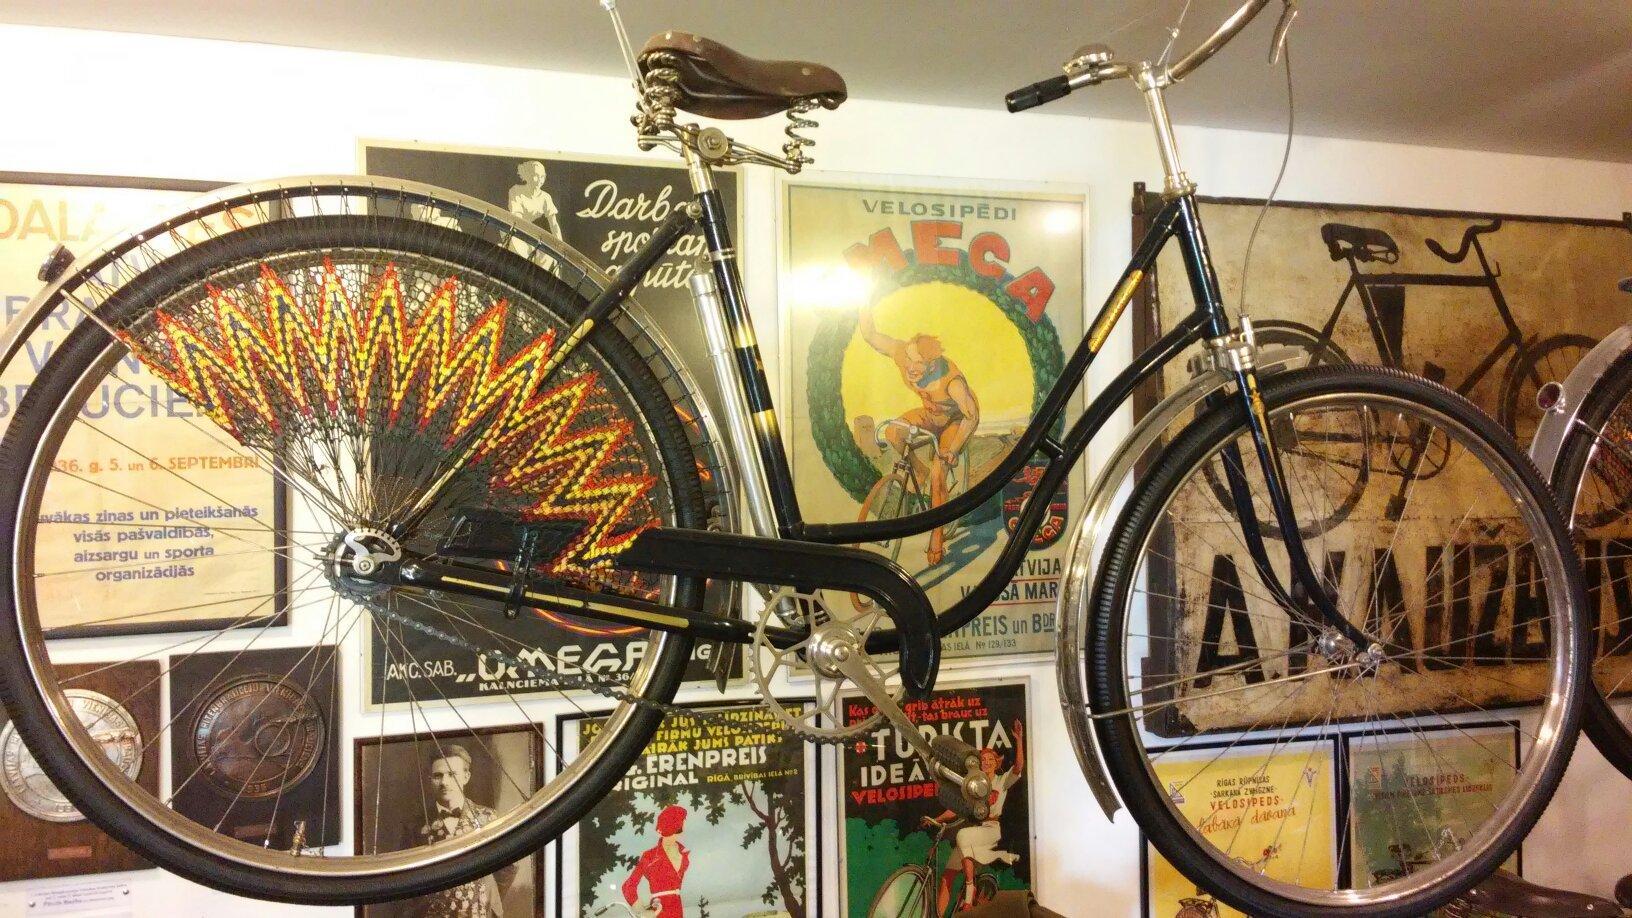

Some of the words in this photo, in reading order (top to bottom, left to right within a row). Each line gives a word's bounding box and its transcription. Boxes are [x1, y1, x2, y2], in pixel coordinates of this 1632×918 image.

[862, 199, 1017, 221] VELOSIPĒDI
[128, 462, 144, 471] un
[140, 510, 159, 521] un
[74, 550, 138, 563] aizsargu
[144, 551, 160, 560] un
[164, 545, 214, 560] sporta
[1012, 619, 1028, 634] un
[646, 745, 767, 774] ERENPREIS
